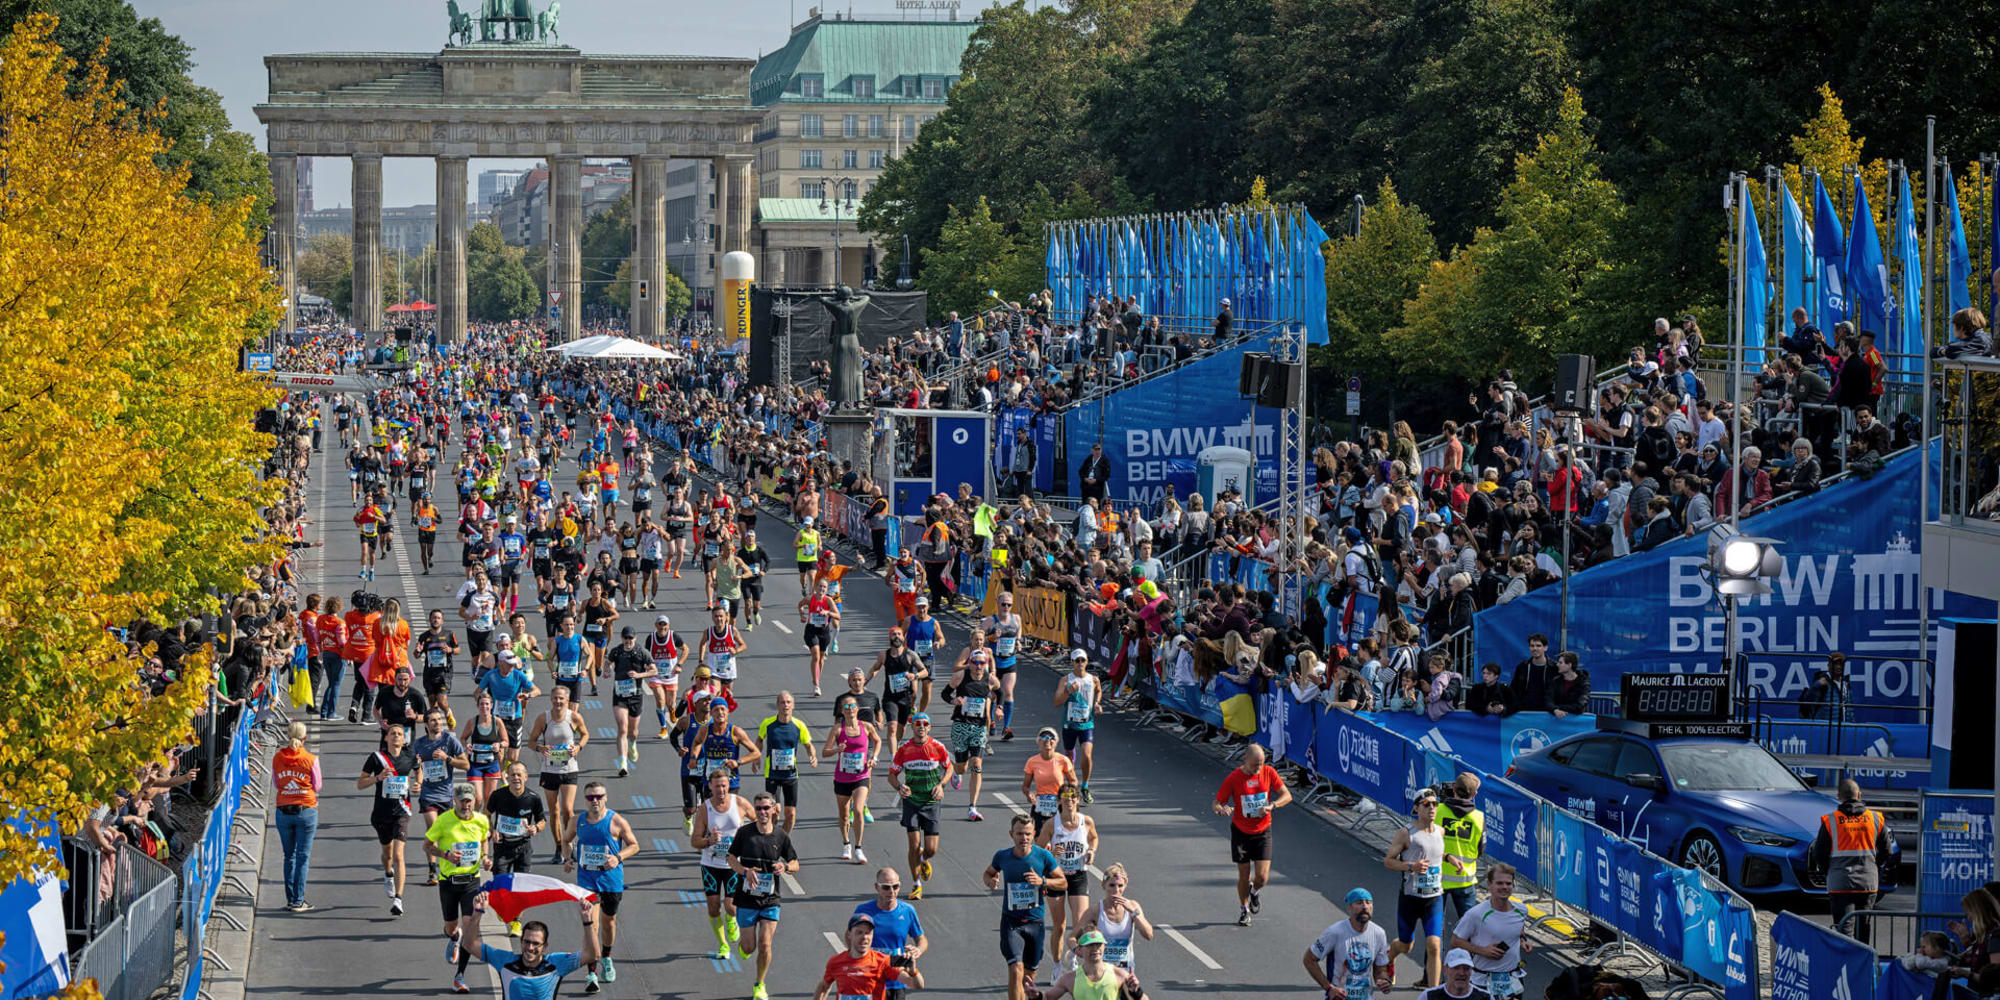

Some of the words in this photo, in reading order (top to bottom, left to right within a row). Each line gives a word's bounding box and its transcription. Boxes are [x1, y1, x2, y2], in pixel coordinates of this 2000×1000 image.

[896, 0, 927, 9] HOTEL
[291, 376, 335, 386] mateco
[1127, 427, 1217, 457] BMW
[1669, 615, 1840, 652] BERLIN
[1631, 675, 1670, 686] MAURICE
[1687, 676, 1726, 687] LACROIX
[1669, 661, 1933, 699] RAHON
[1685, 725, 1707, 735] 100%
[1351, 729, 1379, 766] 万达体育
[278, 771, 305, 779] BERLIN
[1568, 797, 1585, 809] BMW
[1607, 810, 1619, 821] THE
[1776, 944, 1797, 969] MW
[1774, 966, 1797, 984] RLIN
[1772, 983, 1809, 1000] ATHON
